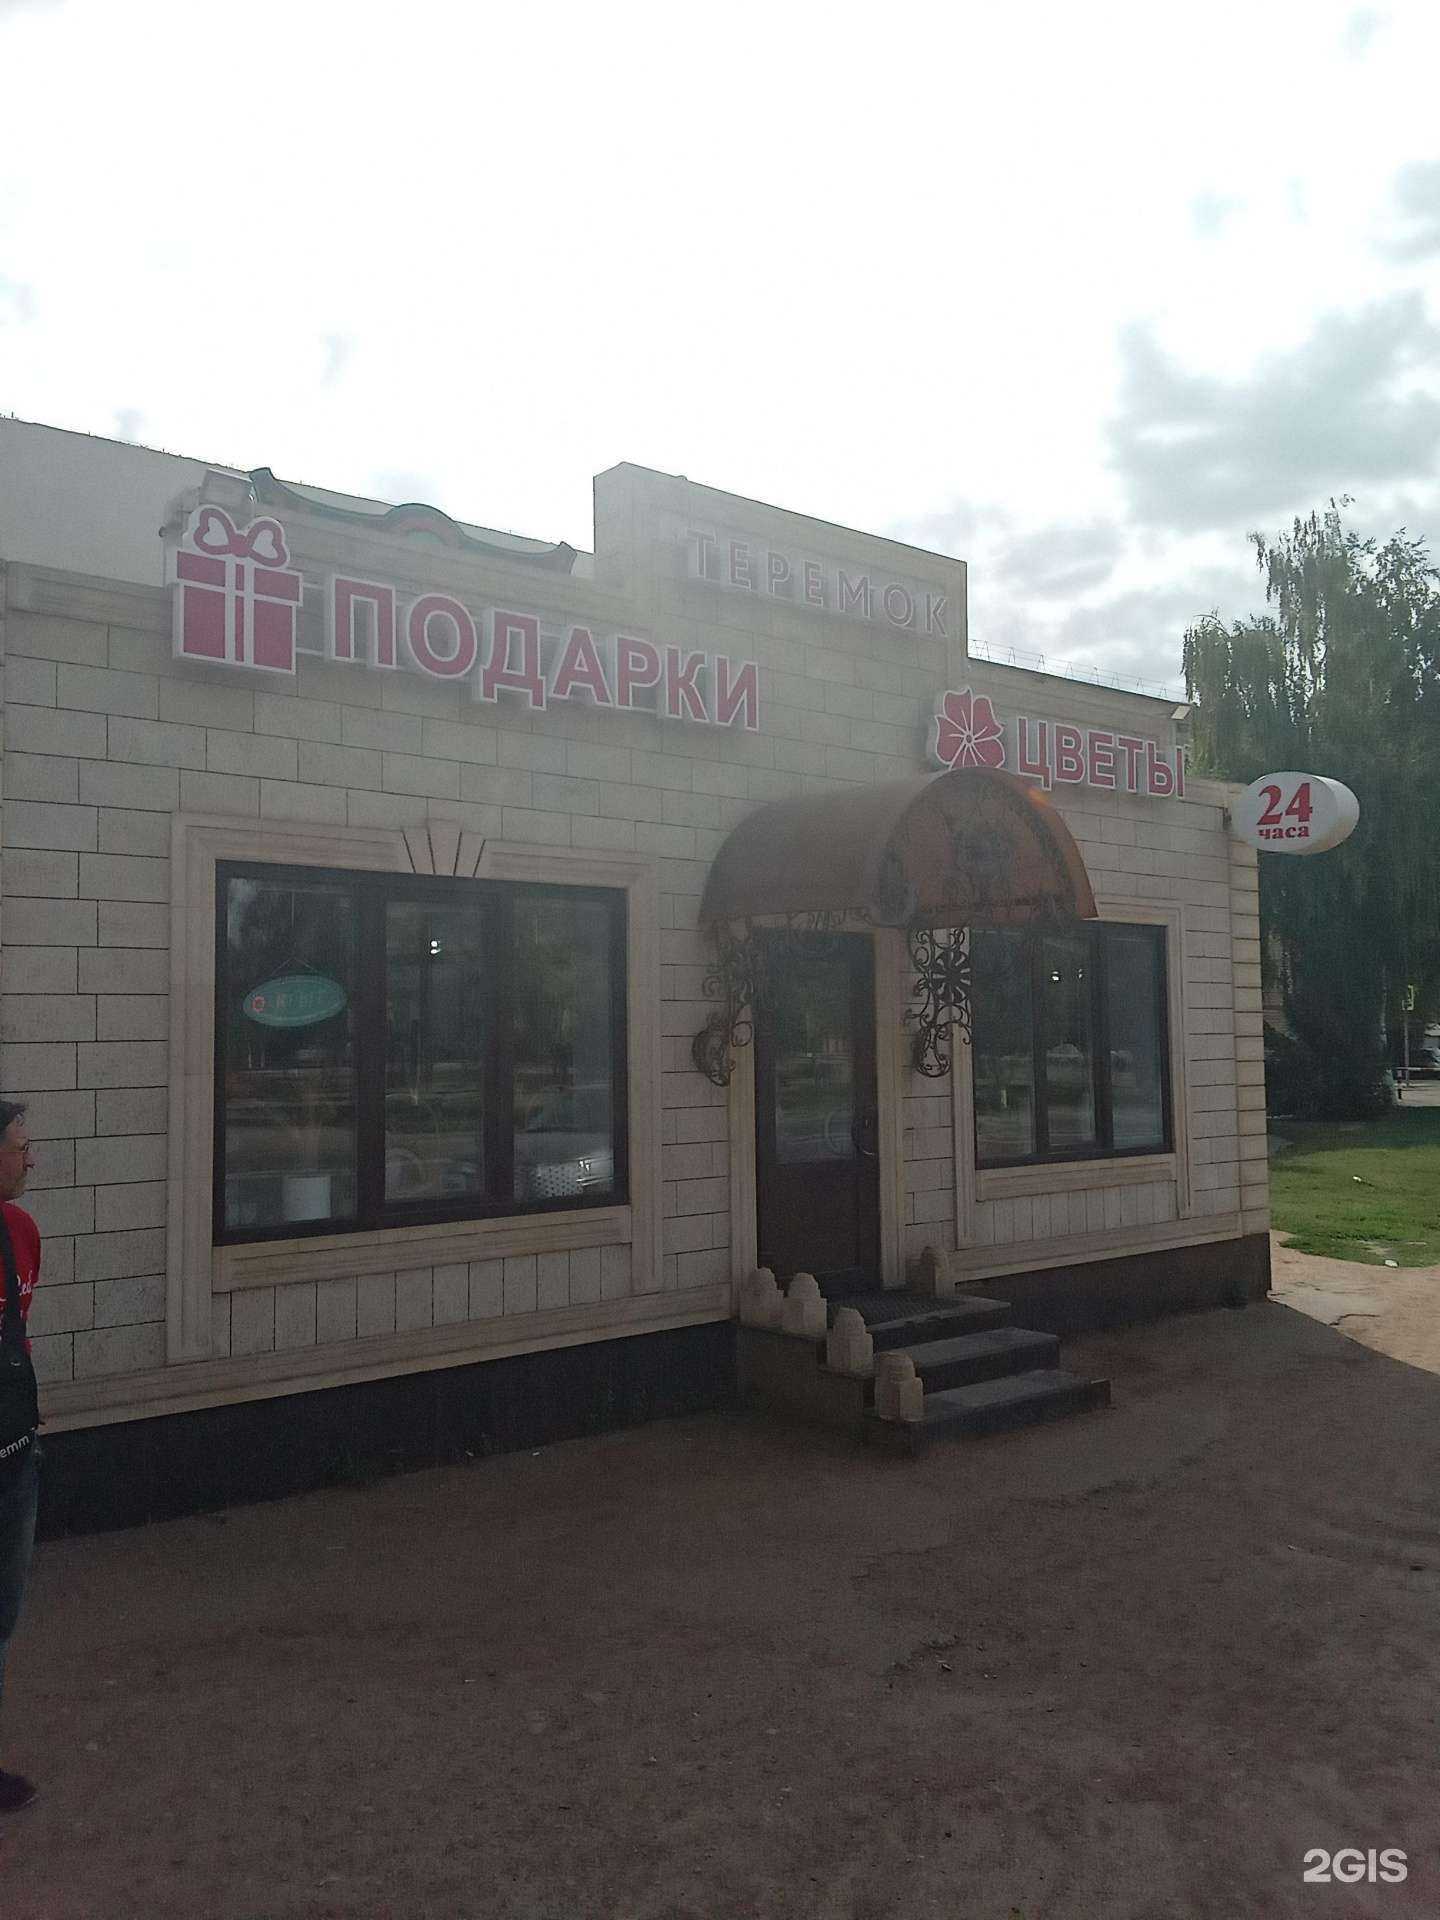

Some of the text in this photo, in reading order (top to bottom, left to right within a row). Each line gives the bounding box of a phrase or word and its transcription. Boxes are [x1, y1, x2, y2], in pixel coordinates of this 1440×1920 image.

[684, 529, 948, 638] ТЕРЕМОК
[331, 574, 760, 731] ПОДАРКИ
[1018, 716, 1185, 799] ЦВЕТЫ
[1256, 783, 1313, 826] 24
[1258, 825, 1310, 840] часа
